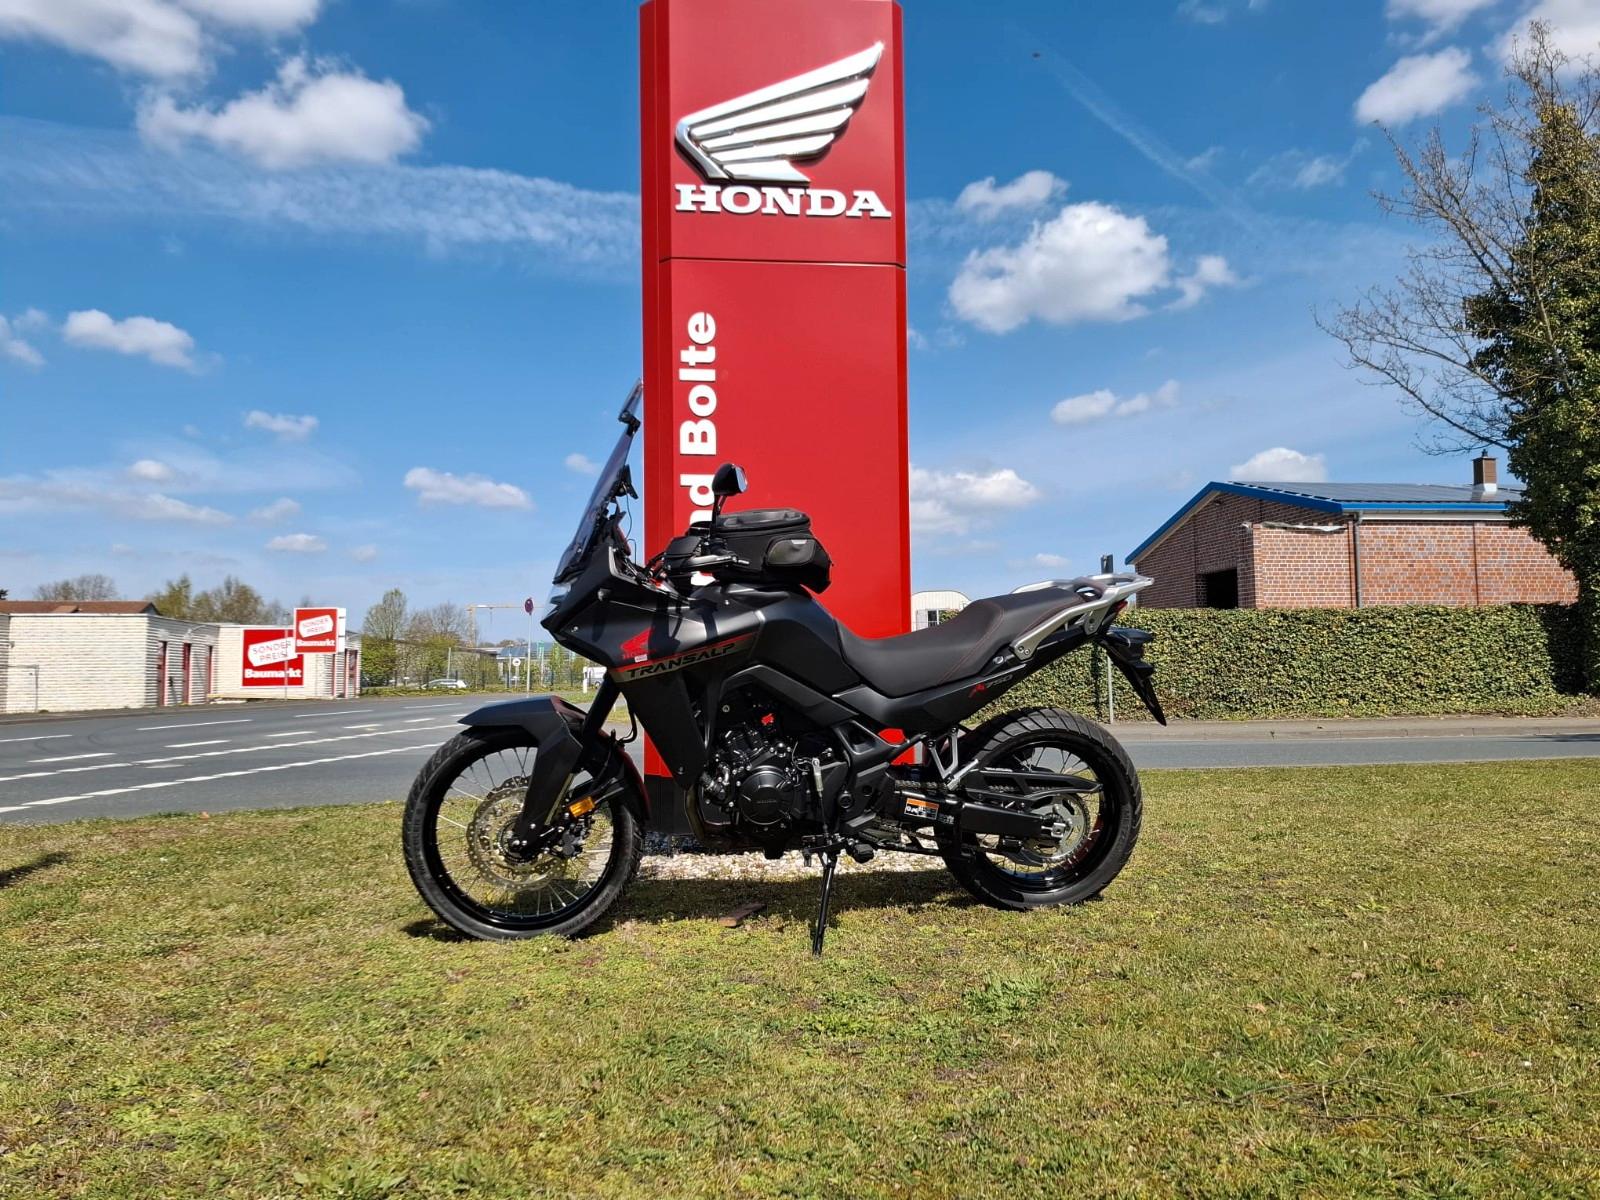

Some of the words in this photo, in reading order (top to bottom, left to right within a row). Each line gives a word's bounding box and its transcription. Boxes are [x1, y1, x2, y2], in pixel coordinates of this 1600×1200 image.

[674, 183, 892, 219] HONDA
[679, 311, 718, 456] Bolte
[252, 640, 291, 655] SONDER
[296, 638, 336, 647] Baumarkt
[259, 651, 288, 661] PREIS
[627, 643, 736, 678] TRANSALP
[244, 668, 302, 678] Baumarkt
